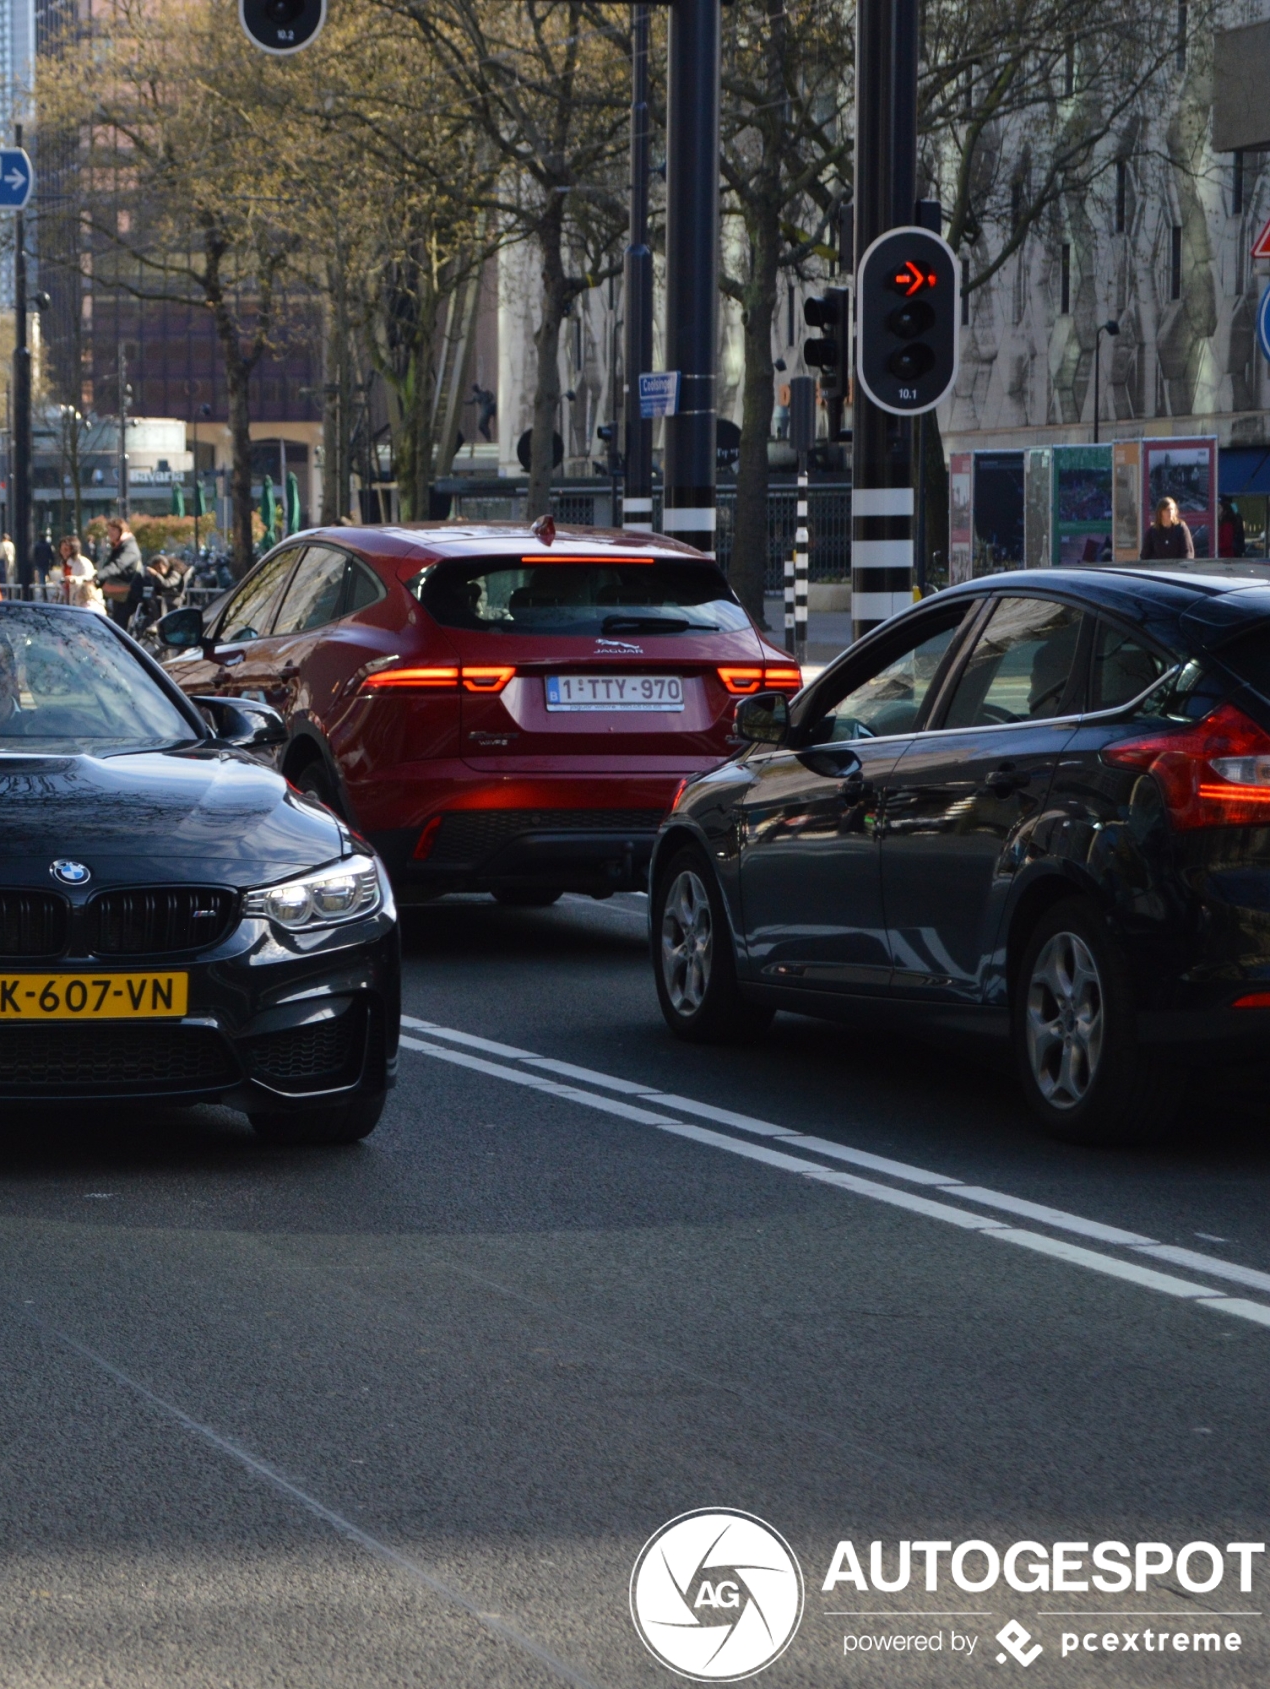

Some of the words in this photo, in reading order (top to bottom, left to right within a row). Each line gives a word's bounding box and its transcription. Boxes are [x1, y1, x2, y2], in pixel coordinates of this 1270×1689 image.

[277, 29, 295, 40] 10.2
[898, 388, 917, 399] 10.1
[563, 678, 680, 700] 1-TTY-970
[550, 691, 558, 701] B
[0, 977, 173, 1013] K-607-VN
